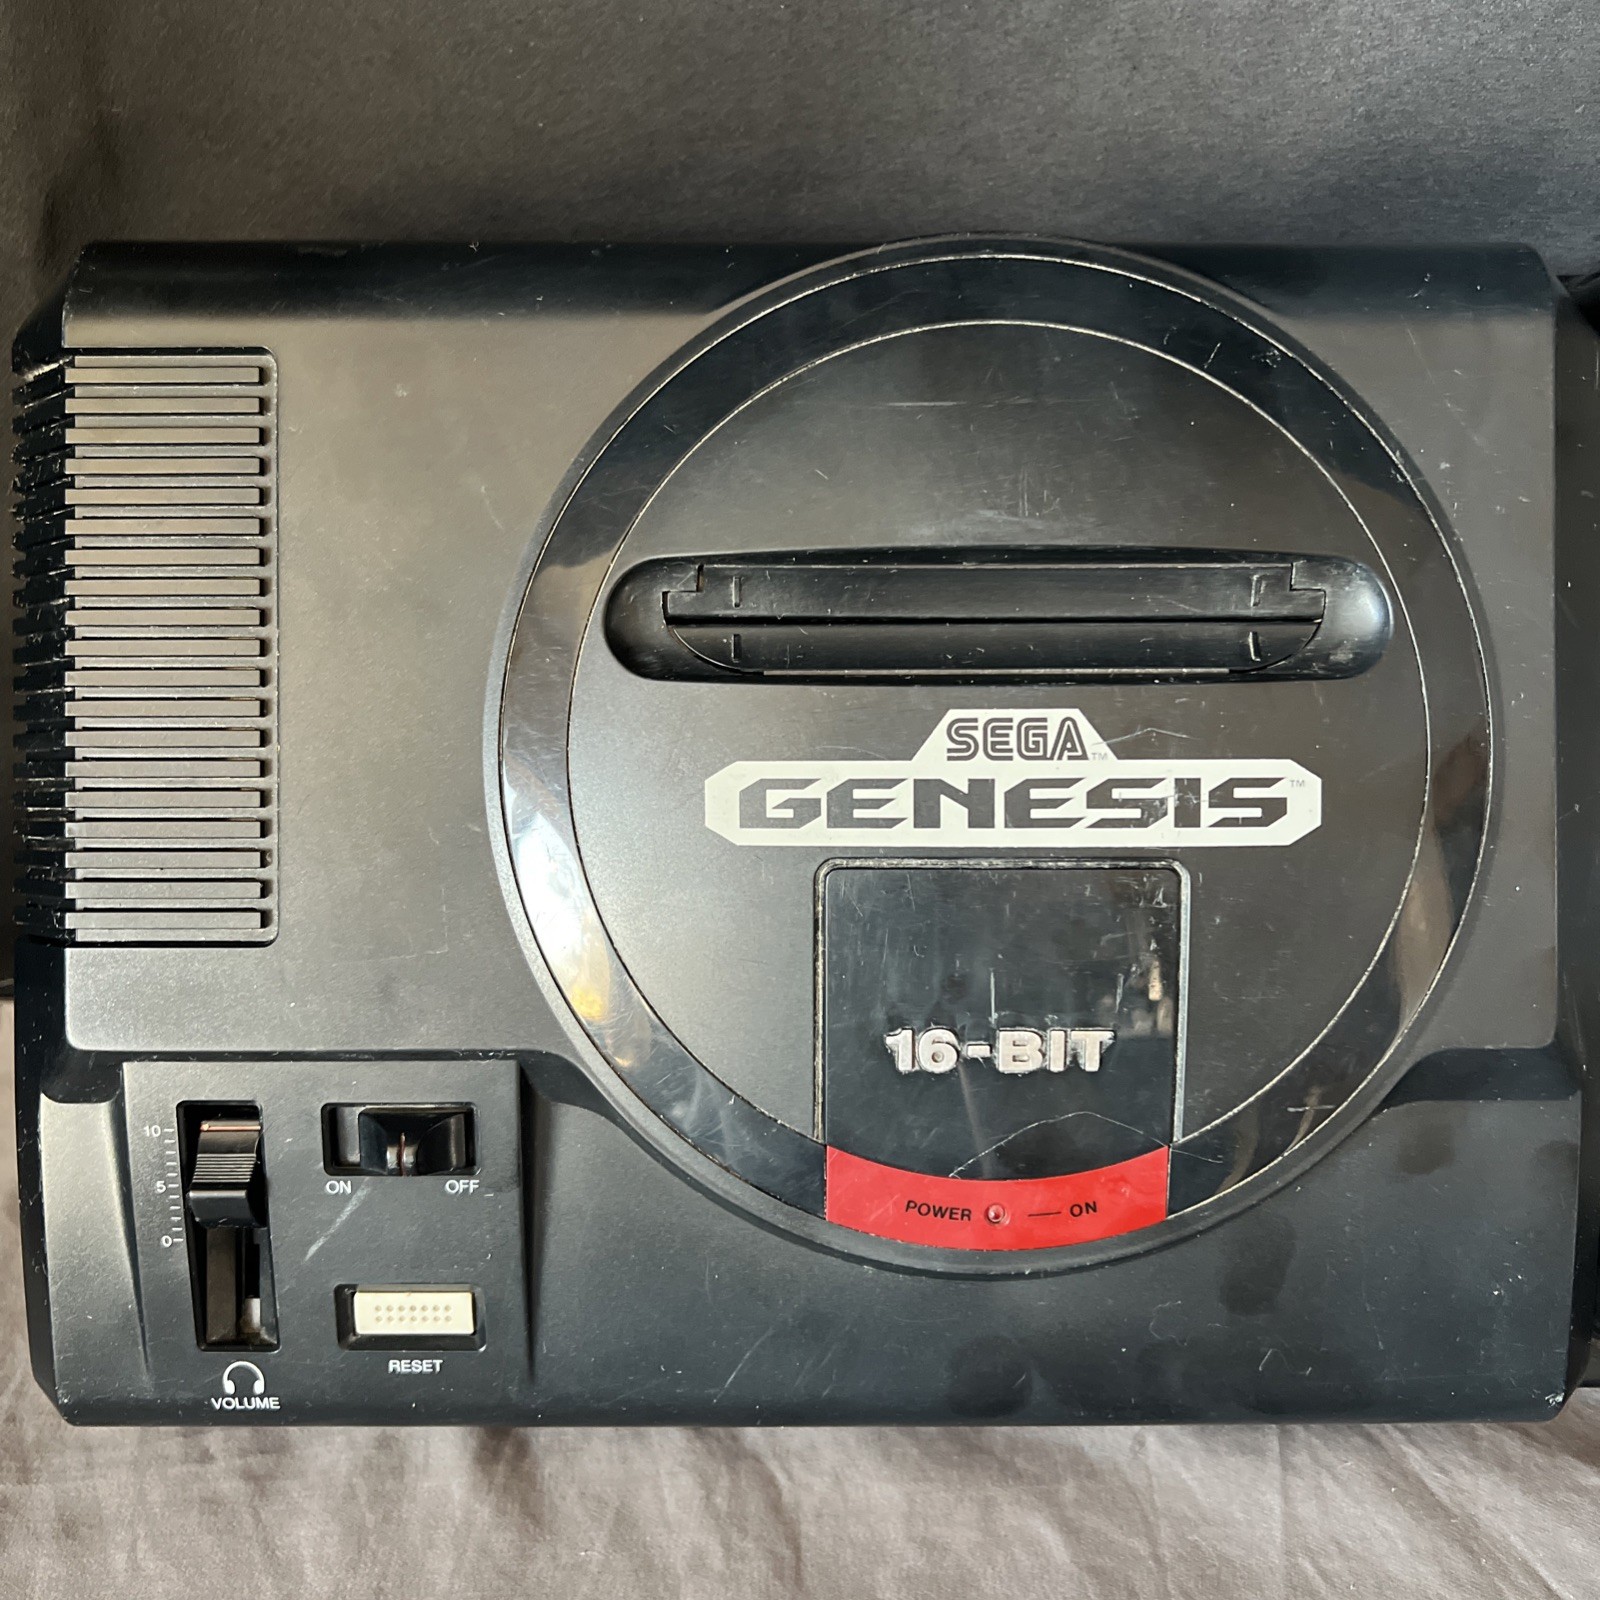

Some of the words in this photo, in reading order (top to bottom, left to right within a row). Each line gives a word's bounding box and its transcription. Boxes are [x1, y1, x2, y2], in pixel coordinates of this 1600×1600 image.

[946, 717, 1088, 760] SEGA
[739, 777, 1287, 828] GENESIS
[885, 1027, 1115, 1074] 16-BIT
[143, 1125, 161, 1137] 10
[156, 1181, 166, 1193] 5
[325, 1180, 352, 1195] ON
[445, 1179, 480, 1195] OFF
[905, 1201, 971, 1221] POWER
[1069, 1201, 1098, 1218] ON
[161, 1235, 172, 1248] 0
[388, 1359, 443, 1374] RESET
[211, 1396, 281, 1411] VOLUME
